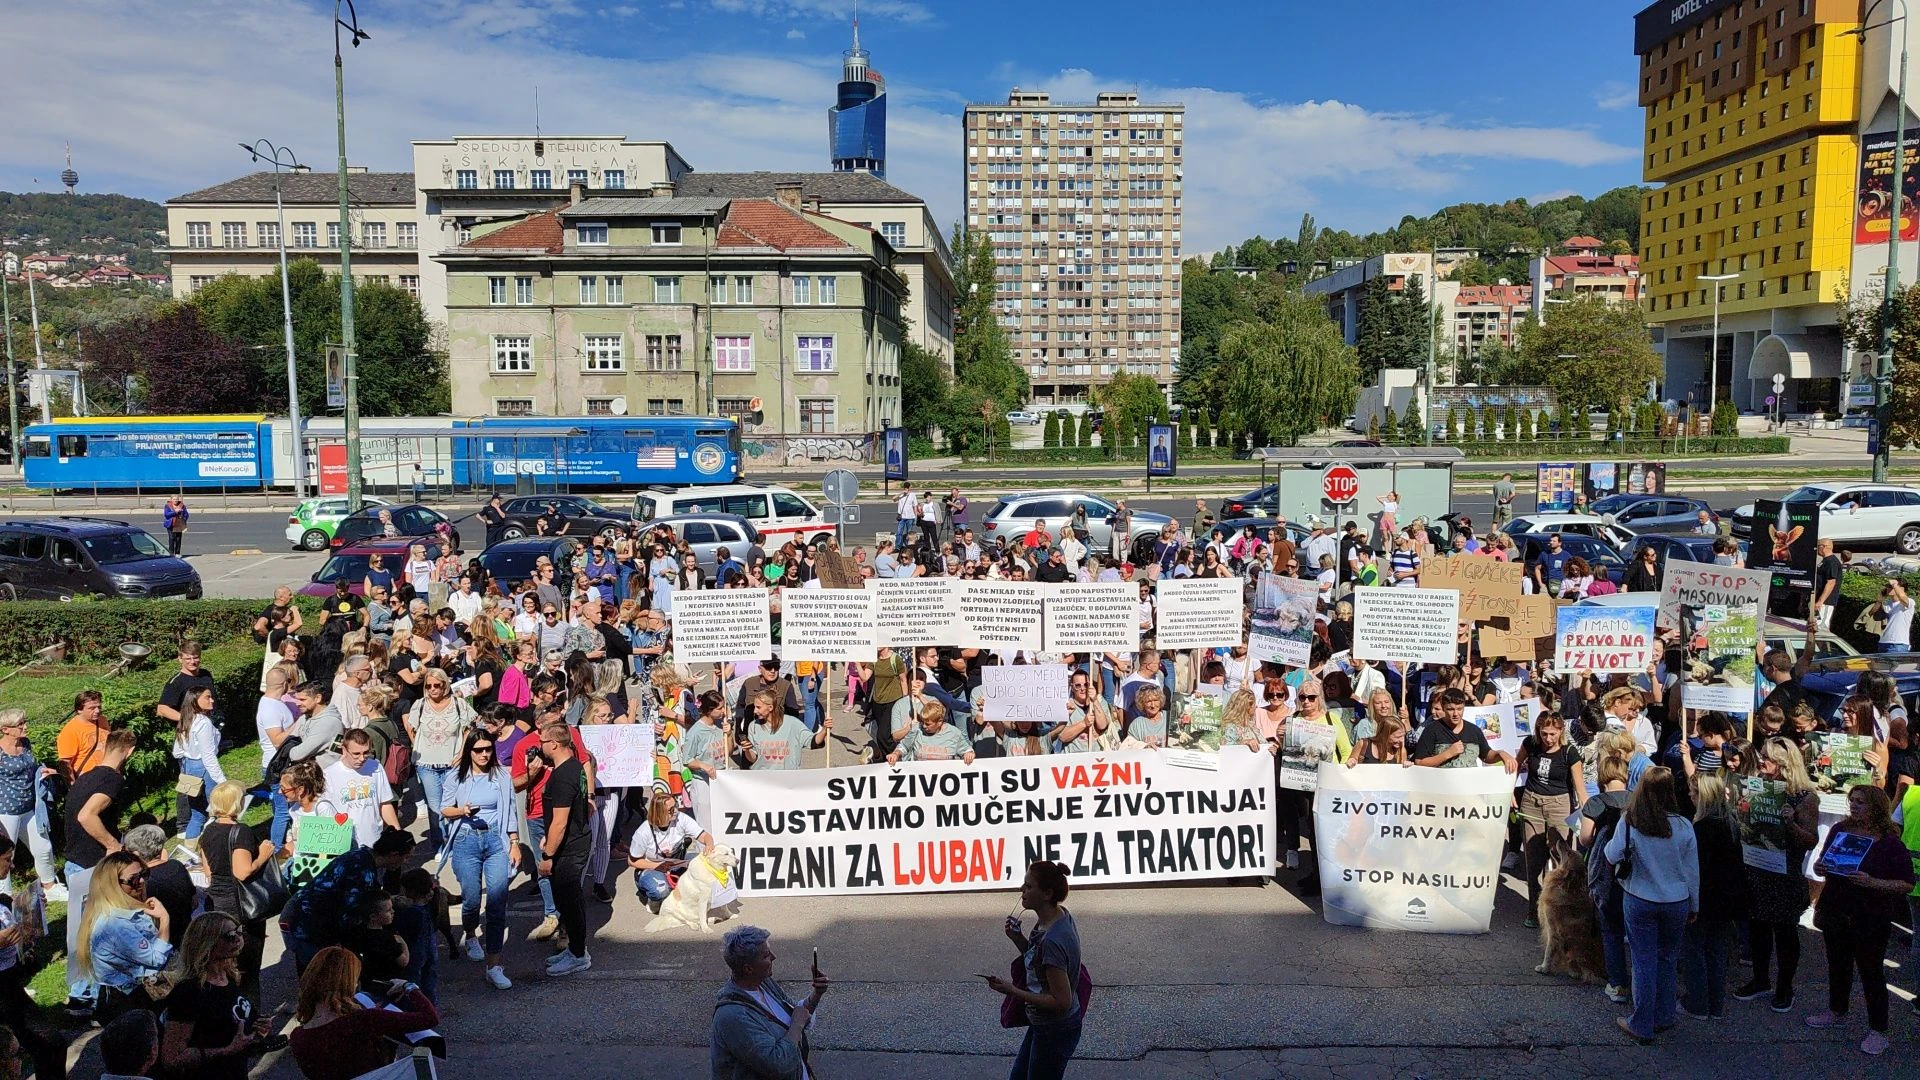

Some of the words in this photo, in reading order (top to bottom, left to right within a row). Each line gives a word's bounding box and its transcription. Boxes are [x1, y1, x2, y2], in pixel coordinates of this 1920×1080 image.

[1671, 0, 1702, 24] HOTEL
[462, 143, 530, 152] SREDNJA
[548, 141, 618, 152] TEHNIČKA
[1324, 477, 1358, 492] STOP
[1698, 572, 1746, 590] STOP
[1566, 634, 1615, 647] PRAVO
[1621, 634, 1645, 647] NA
[1034, 670, 1065, 681] MEDU
[986, 686, 1016, 699] UBIO
[1005, 705, 1053, 718] ZENICA
[828, 776, 876, 800] SVI
[888, 769, 989, 798] ŽIVOTI
[1000, 768, 1041, 793] SU
[1051, 757, 1152, 790] VAŽNI,
[724, 805, 924, 835] ZAUSTAVIMO
[936, 795, 1084, 827] MUČENJE
[1093, 787, 1266, 818] ŽIVOTINJA!
[1332, 797, 1436, 817] ŽIVOTINJE
[1444, 805, 1503, 819] IMAJU
[310, 832, 342, 844] MEDU
[1381, 826, 1455, 840] PRAVA!
[732, 846, 836, 890] VEZANI
[846, 844, 884, 887] ZA
[893, 837, 1012, 886] LJUBAV,
[1024, 834, 1061, 868] NE
[1071, 832, 1110, 877] ZA
[1118, 824, 1265, 874] TRAKTOR!
[1343, 869, 1394, 884] STOP
[1402, 872, 1490, 888] NASILJU!
